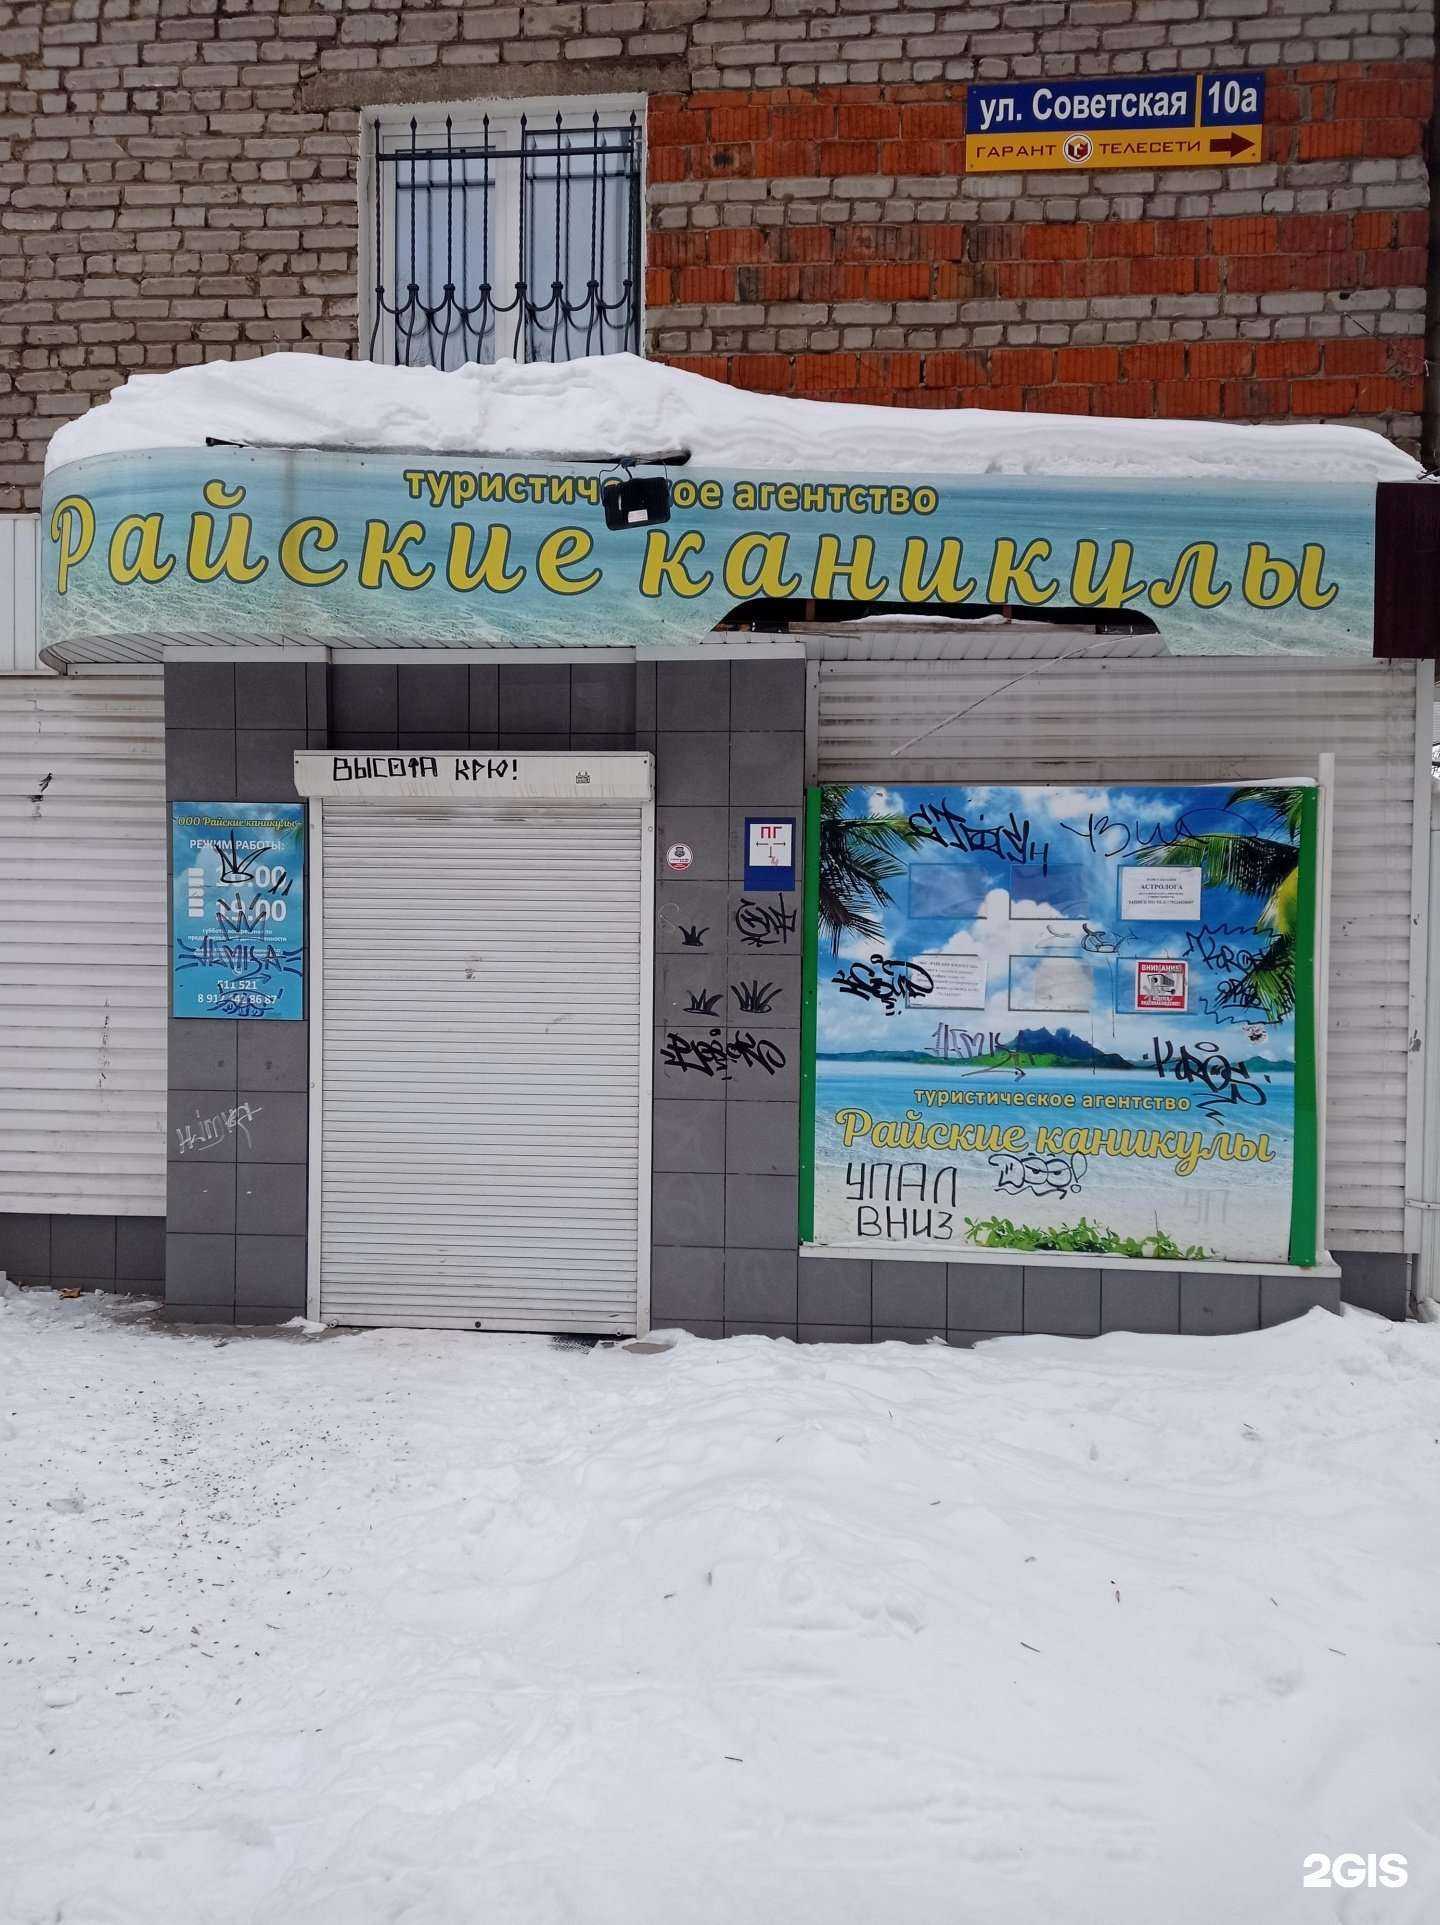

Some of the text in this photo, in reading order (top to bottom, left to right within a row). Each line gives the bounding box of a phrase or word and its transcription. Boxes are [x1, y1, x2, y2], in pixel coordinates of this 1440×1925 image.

[980, 80, 1257, 130] ул. Советская 10а
[976, 144, 1057, 158] ГАРАНТ
[1098, 140, 1201, 155] ТЕЛЕСЕТИ
[403, 468, 938, 515] туристичое агентство
[49, 478, 1341, 611] Райские каникулы
[189, 839, 233, 849] РЕЖИМ
[761, 826, 782, 839] ПГ
[239, 980, 257, 990] 521
[913, 1087, 1191, 1112] туристическое агентство
[834, 1107, 1276, 1177] Райские каникулы
[846, 1161, 957, 1207] УПАЛ
[858, 1205, 954, 1240] ВНИЗ
